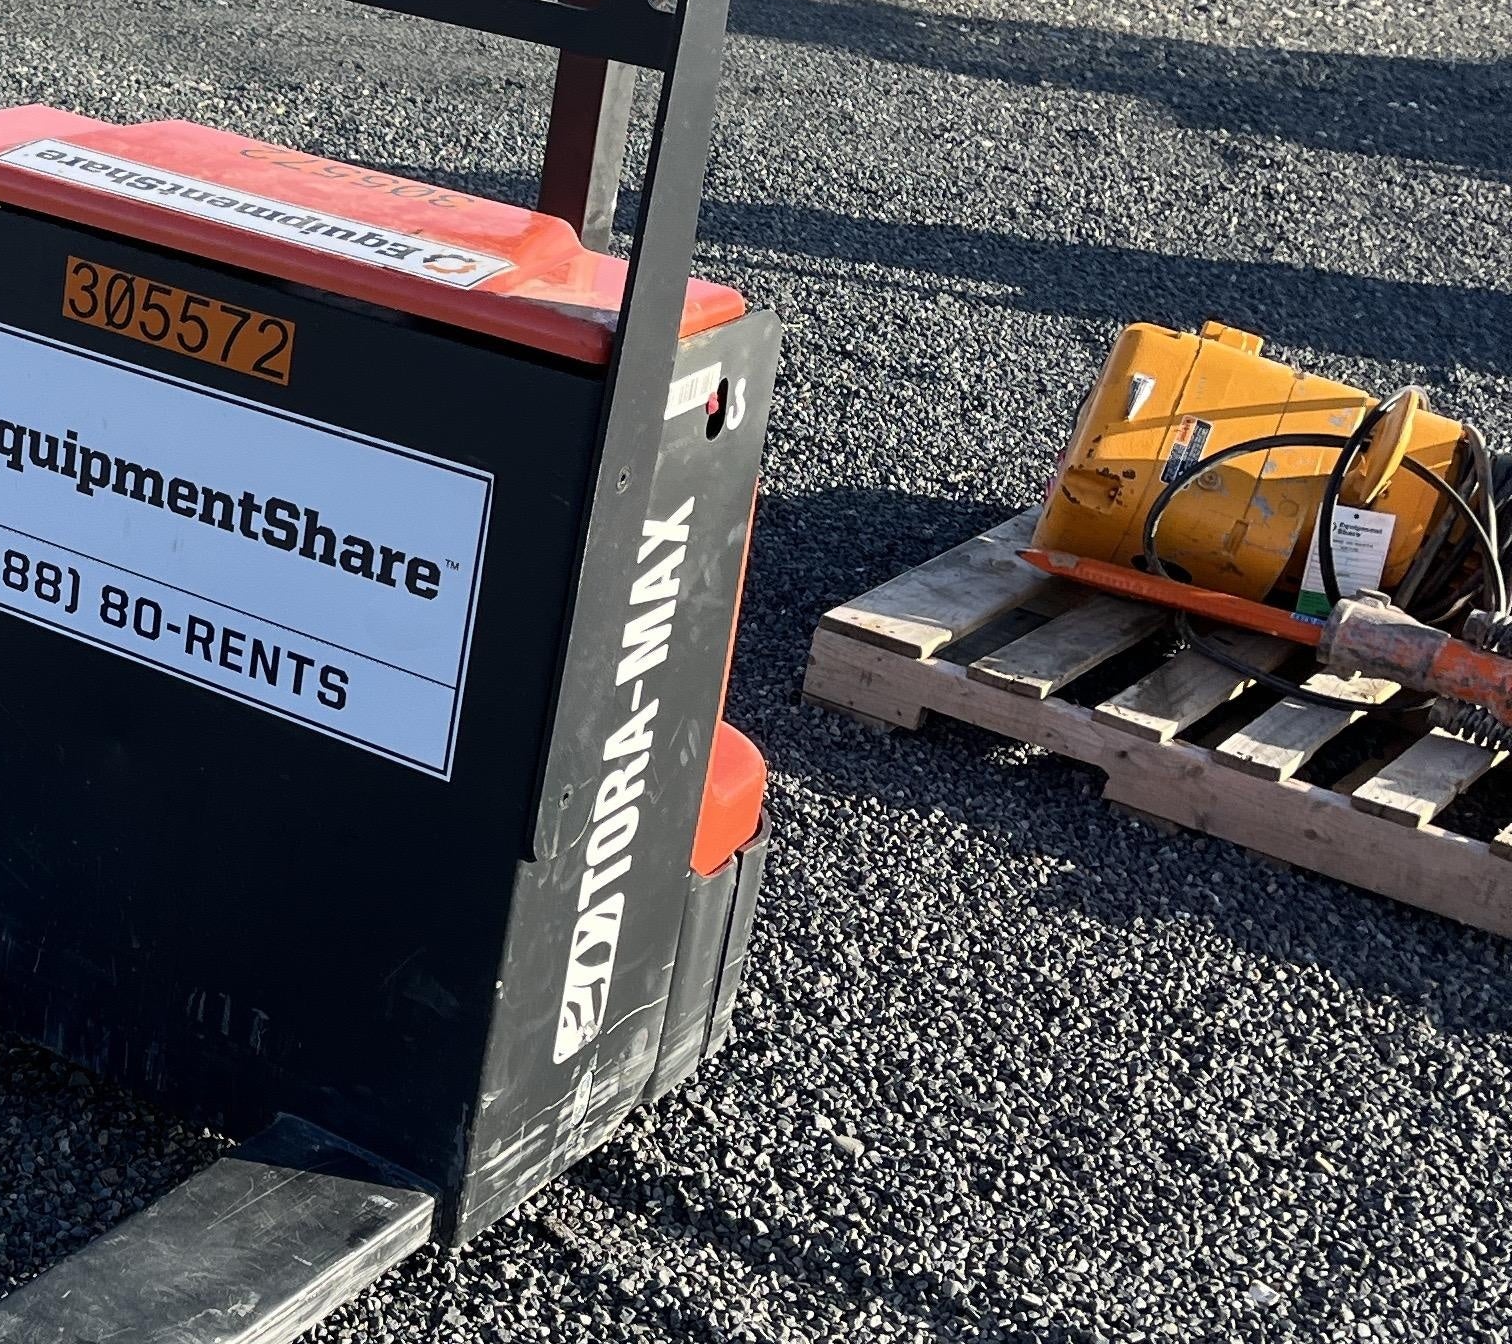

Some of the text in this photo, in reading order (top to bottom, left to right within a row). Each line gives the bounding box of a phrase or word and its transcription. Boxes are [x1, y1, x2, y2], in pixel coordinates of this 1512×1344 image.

[35, 147, 425, 262] EquipmentShare
[69, 262, 289, 380] 305572
[99, 584, 349, 711] 80-RENTS
[577, 496, 696, 913] TORA-MAX
